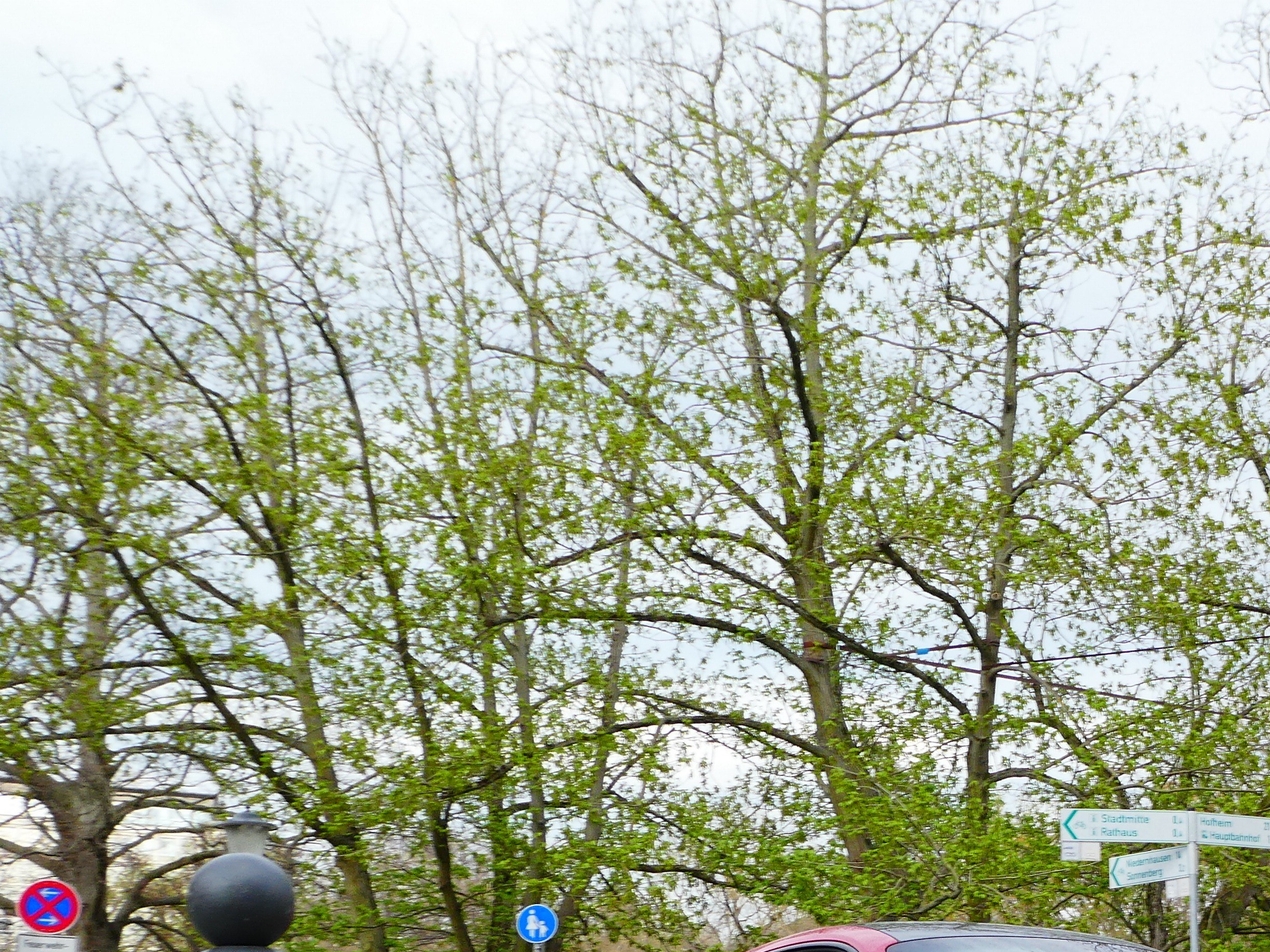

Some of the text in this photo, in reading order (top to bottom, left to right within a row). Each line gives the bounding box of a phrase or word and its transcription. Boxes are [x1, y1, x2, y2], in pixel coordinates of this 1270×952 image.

[1101, 814, 1150, 824] Stadtmitte
[1201, 818, 1233, 828] Hofheim
[1101, 827, 1138, 837] Rathaus
[1211, 832, 1260, 842] Hauptbahnhof
